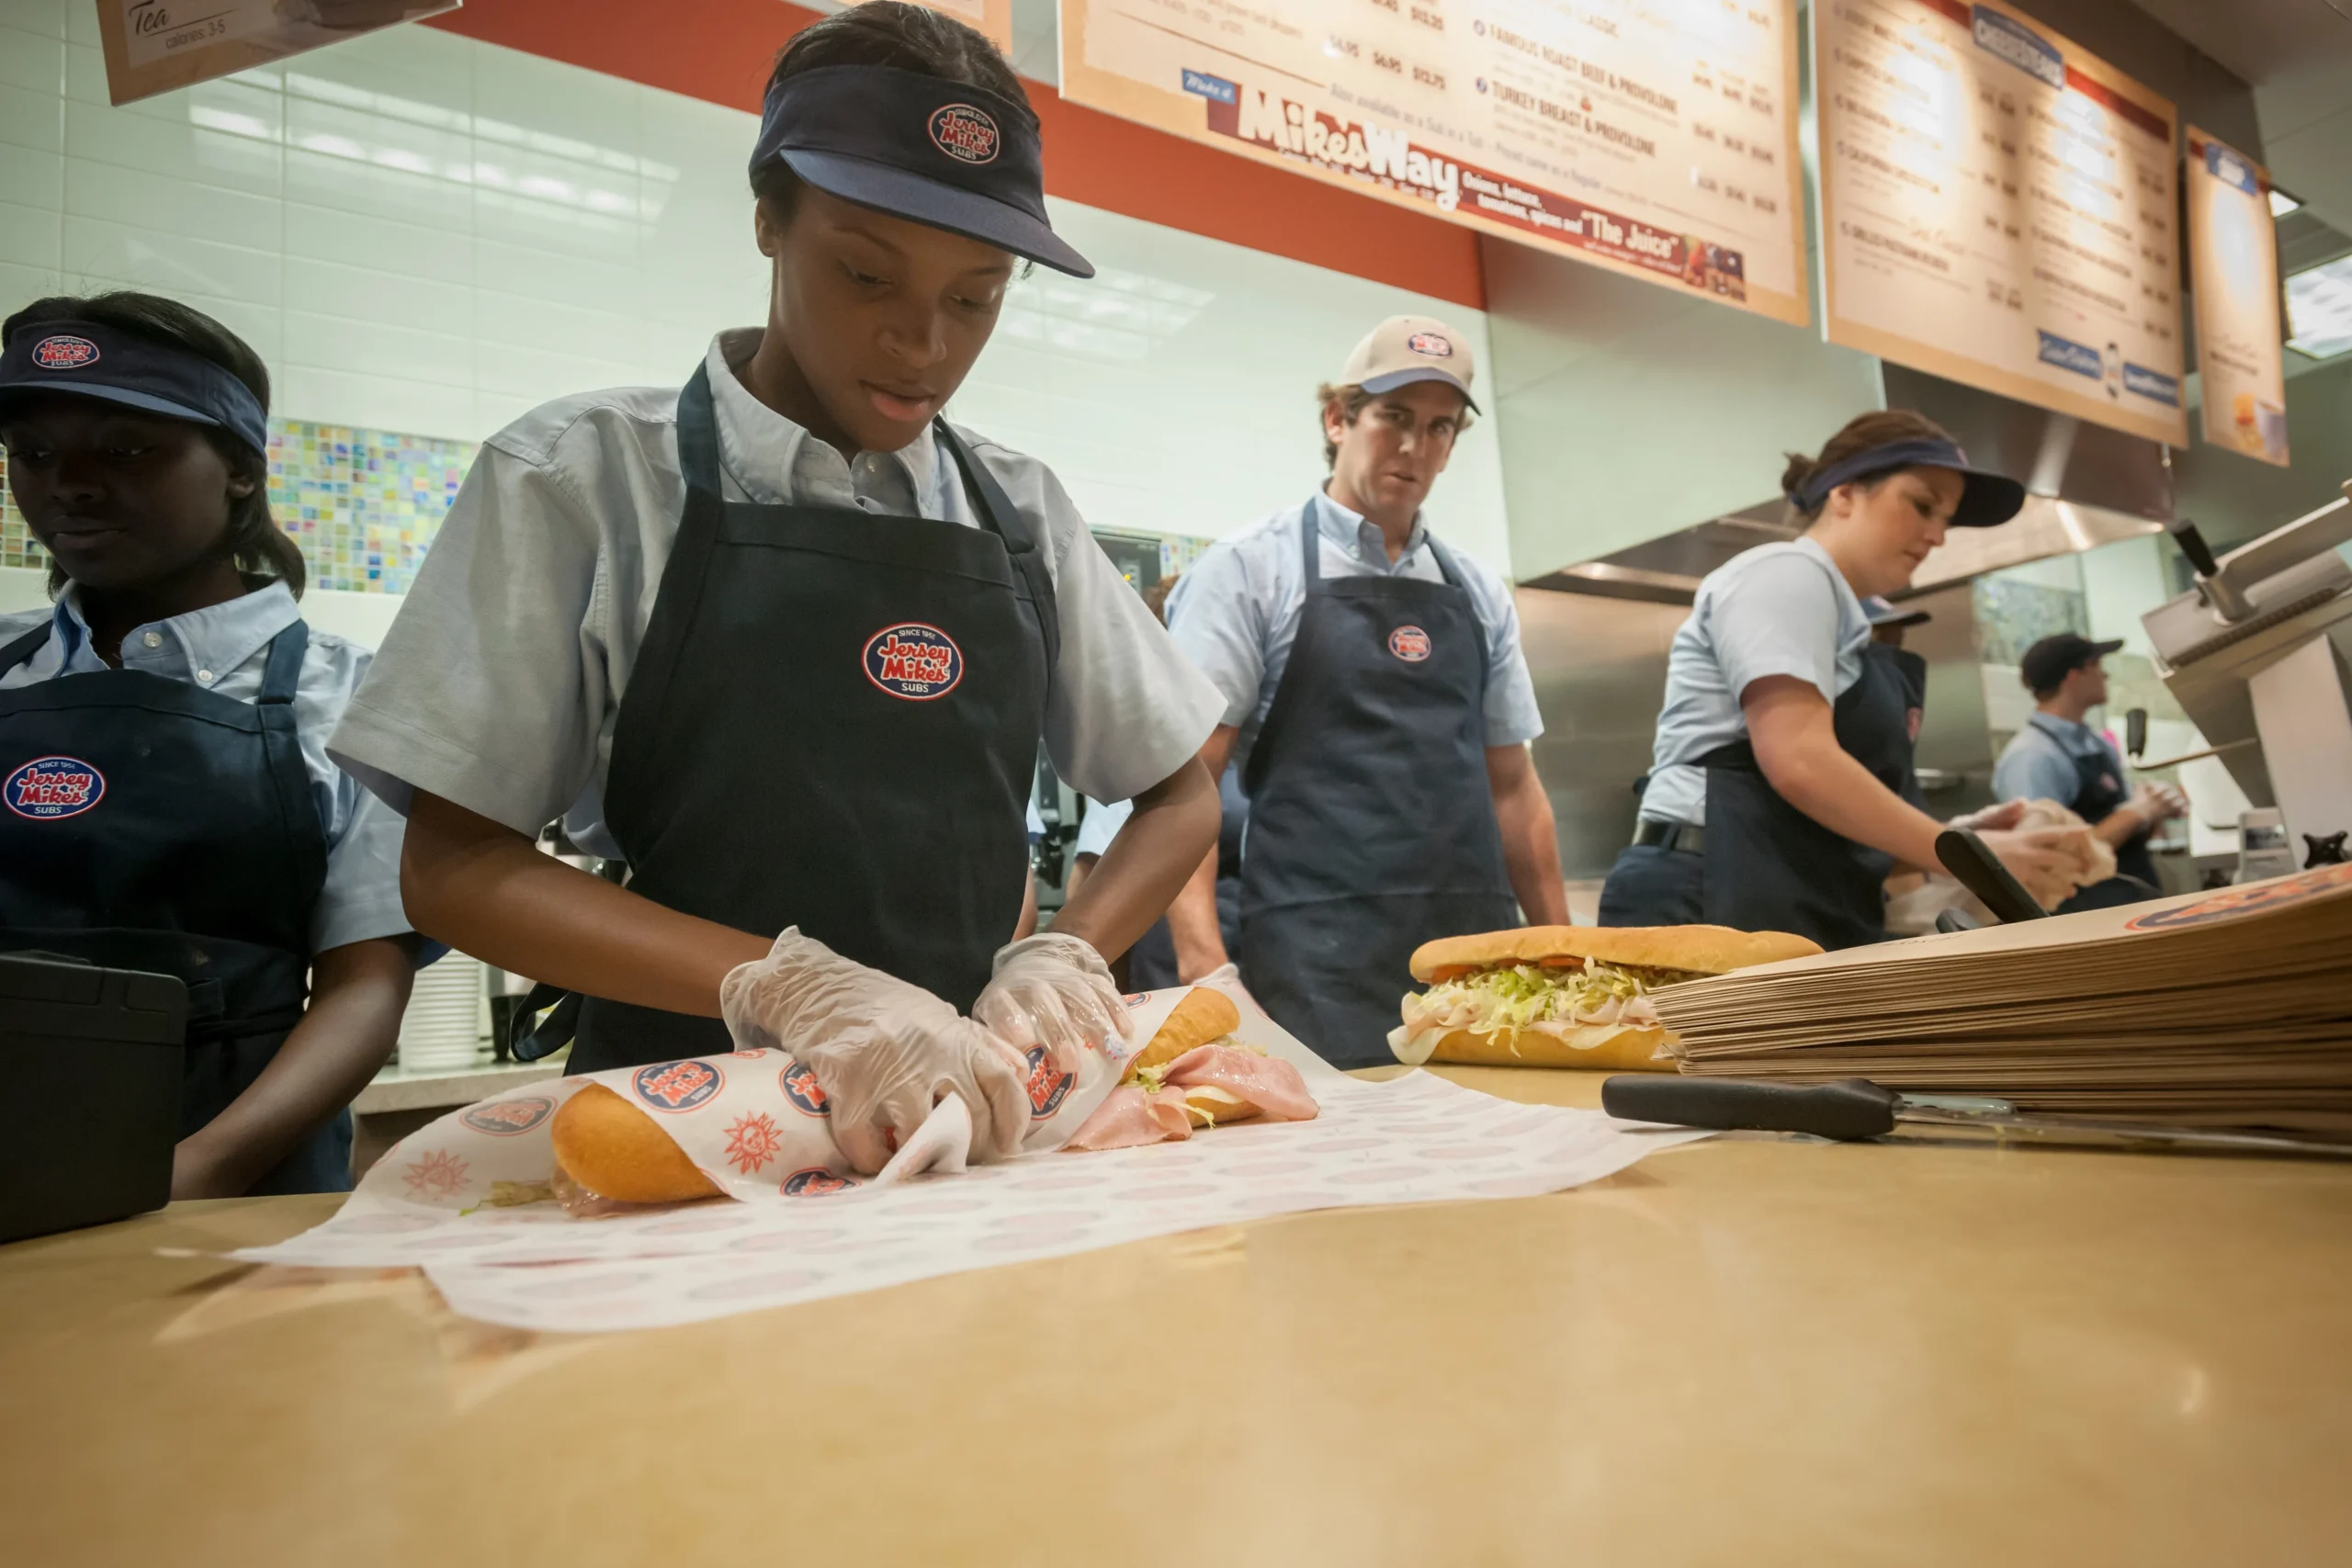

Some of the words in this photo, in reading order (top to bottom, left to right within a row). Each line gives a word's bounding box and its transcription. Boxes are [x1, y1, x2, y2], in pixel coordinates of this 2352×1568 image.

[128, 0, 171, 36] Tea
[1539, 99, 1581, 128] BREAST
[939, 110, 995, 145] Jersey
[951, 145, 978, 160] SUBS
[1363, 118, 1462, 212] Way
[899, 628, 921, 637] SINCE
[877, 634, 952, 668] Jersey
[901, 682, 930, 694] SUBS
[38, 761, 60, 770] SINCE
[17, 768, 93, 792] Jersey
[34, 806, 62, 815] SUBS
